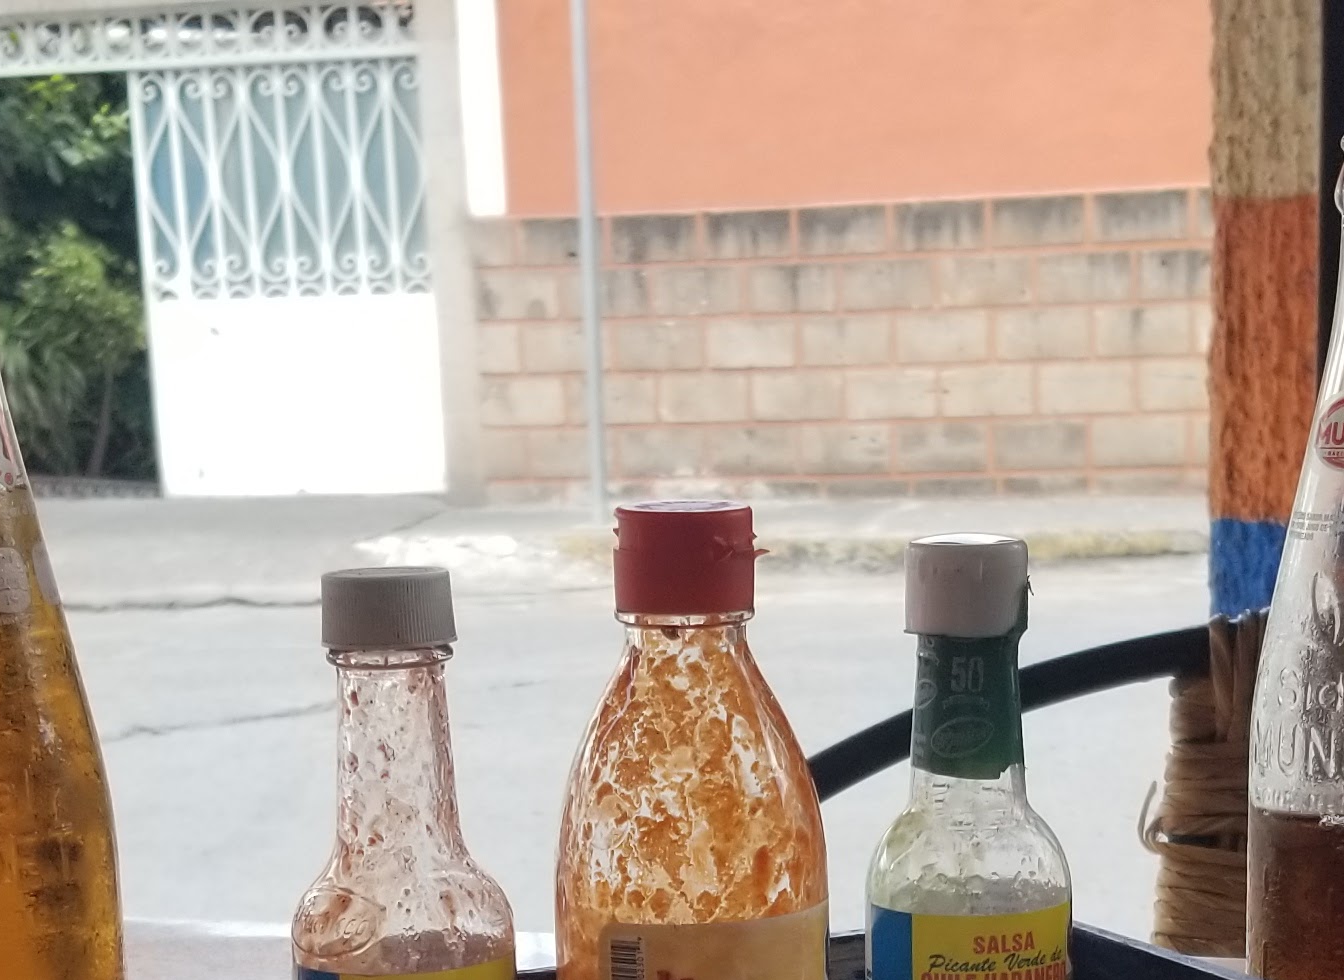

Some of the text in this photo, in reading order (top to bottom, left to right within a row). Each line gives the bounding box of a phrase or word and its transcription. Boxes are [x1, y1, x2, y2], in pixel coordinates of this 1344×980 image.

[950, 655, 984, 692] 50
[973, 931, 1036, 955] SALSA
[928, 953, 996, 973] Picante
[1003, 949, 1046, 972] Verde
